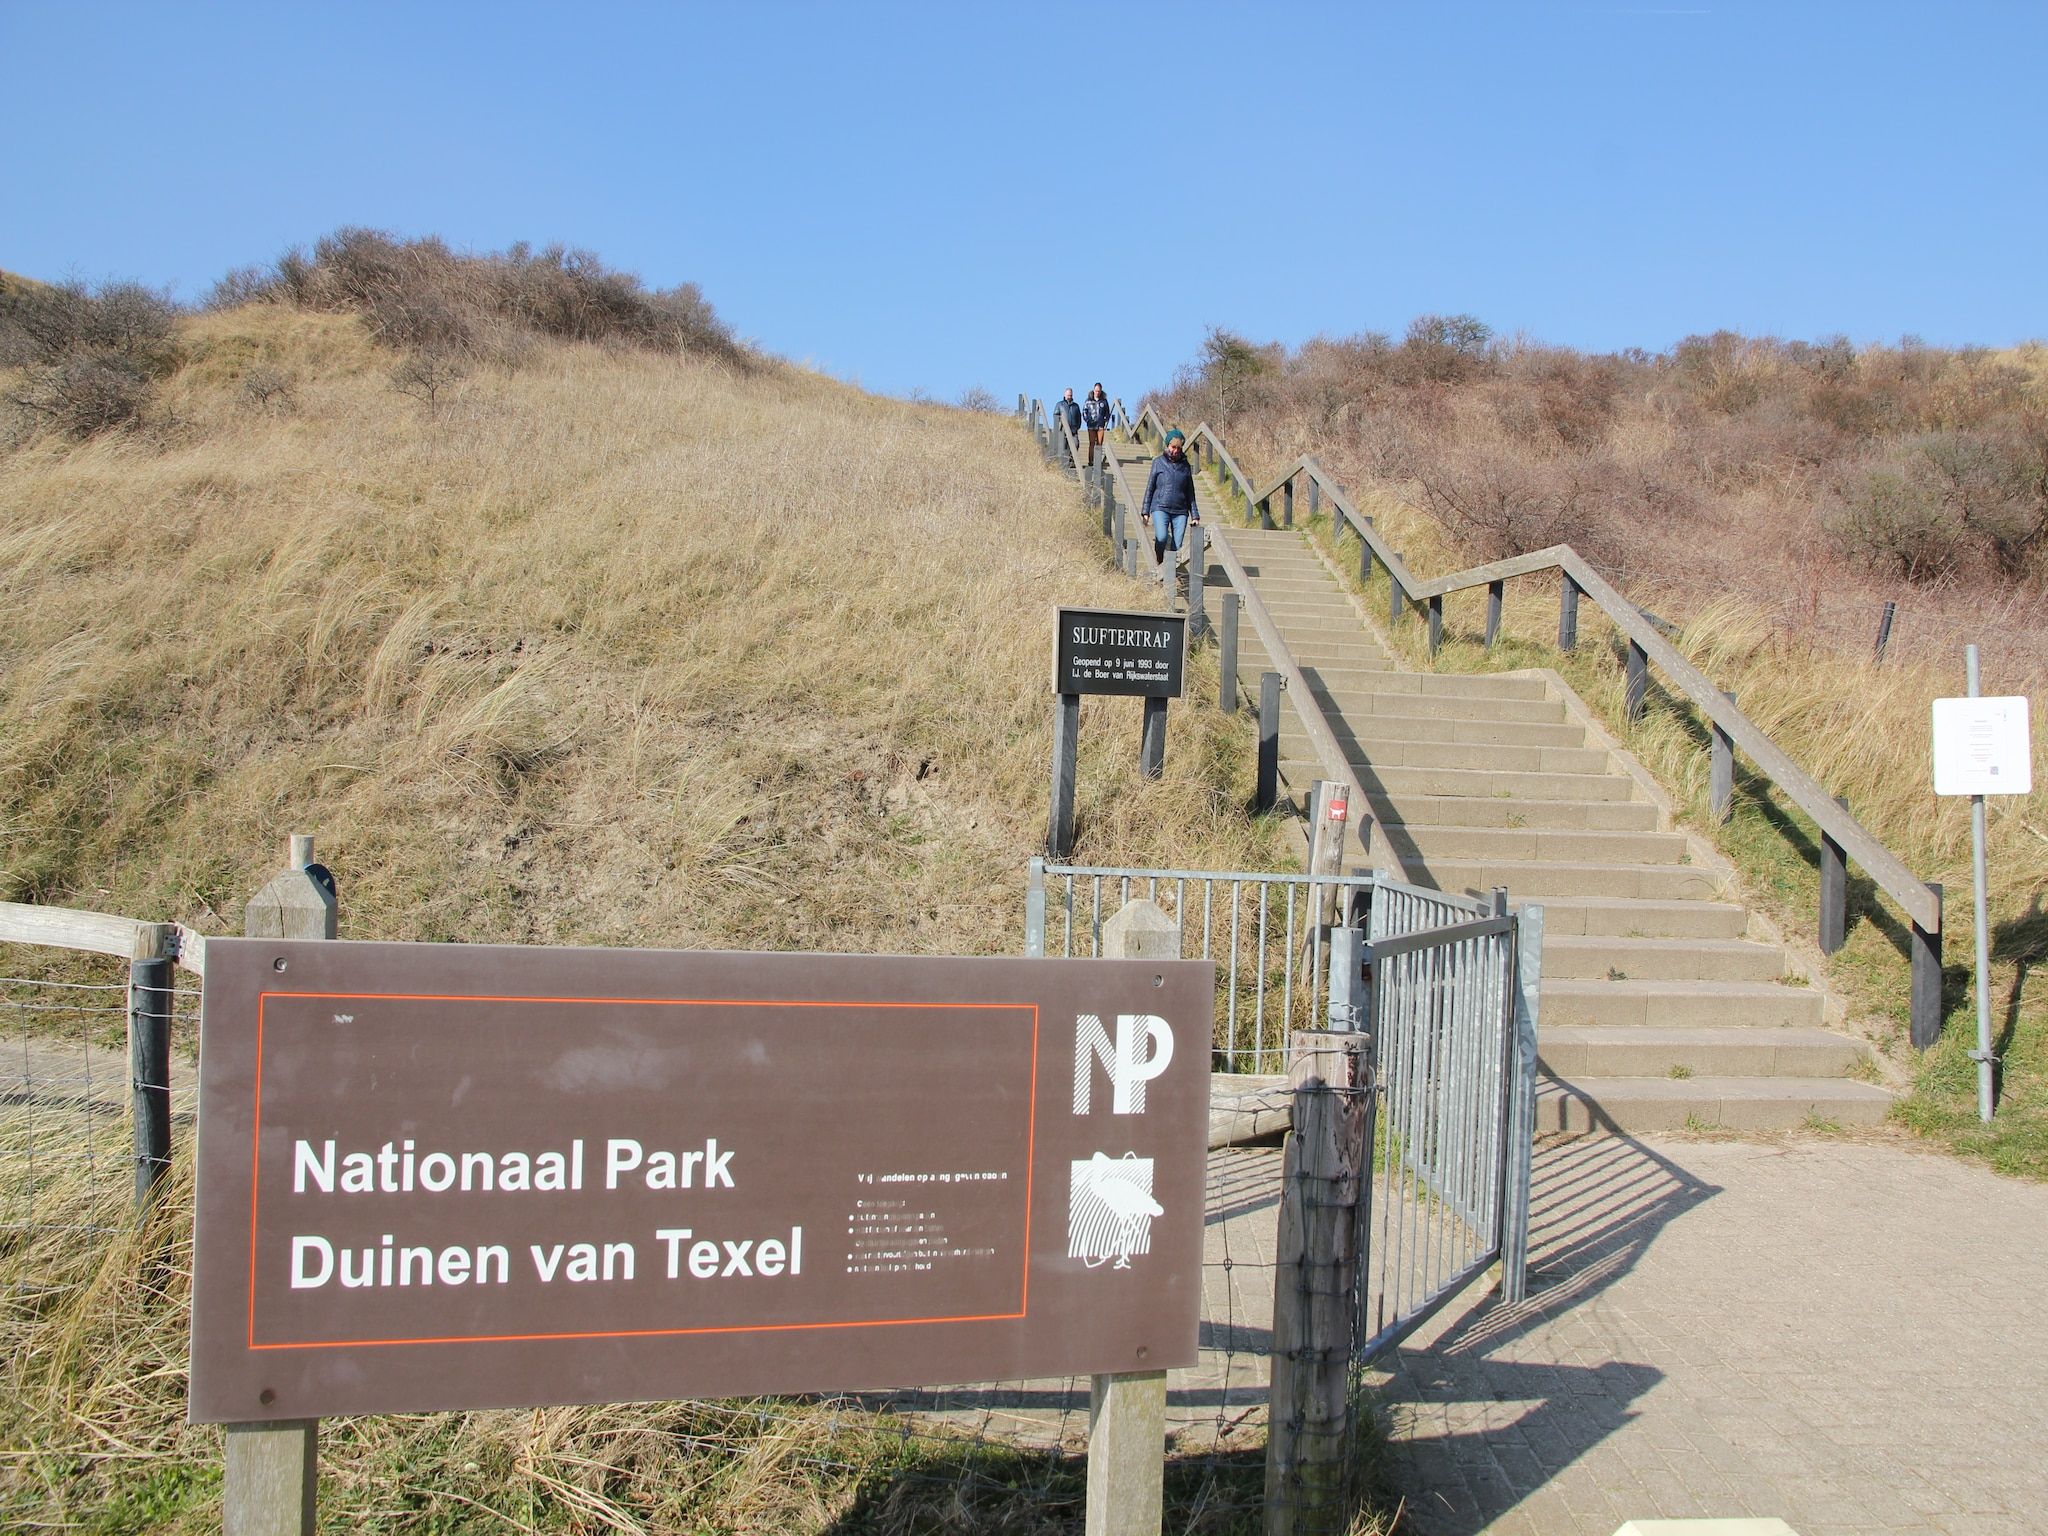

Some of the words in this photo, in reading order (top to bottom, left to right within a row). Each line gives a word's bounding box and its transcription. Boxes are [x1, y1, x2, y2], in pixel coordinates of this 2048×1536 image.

[1072, 626, 1171, 649] SLUFTERTRAP
[1072, 656, 1101, 668] Geopend
[1104, 659, 1113, 669] op
[1115, 659, 1121, 668] 9
[1123, 659, 1135, 670] juni
[1137, 658, 1152, 669] 1993
[1155, 660, 1169, 670] door
[1083, 669, 1092, 679] de
[1094, 669, 1110, 680] Boer
[1112, 672, 1123, 680] van
[1126, 671, 1169, 682] Rijkswaterstaat
[294, 1138, 583, 1193] Nationaal
[606, 1138, 736, 1190] Park
[290, 1233, 509, 1289] Duinen
[530, 1240, 635, 1282] van
[655, 1226, 802, 1279] Texel
